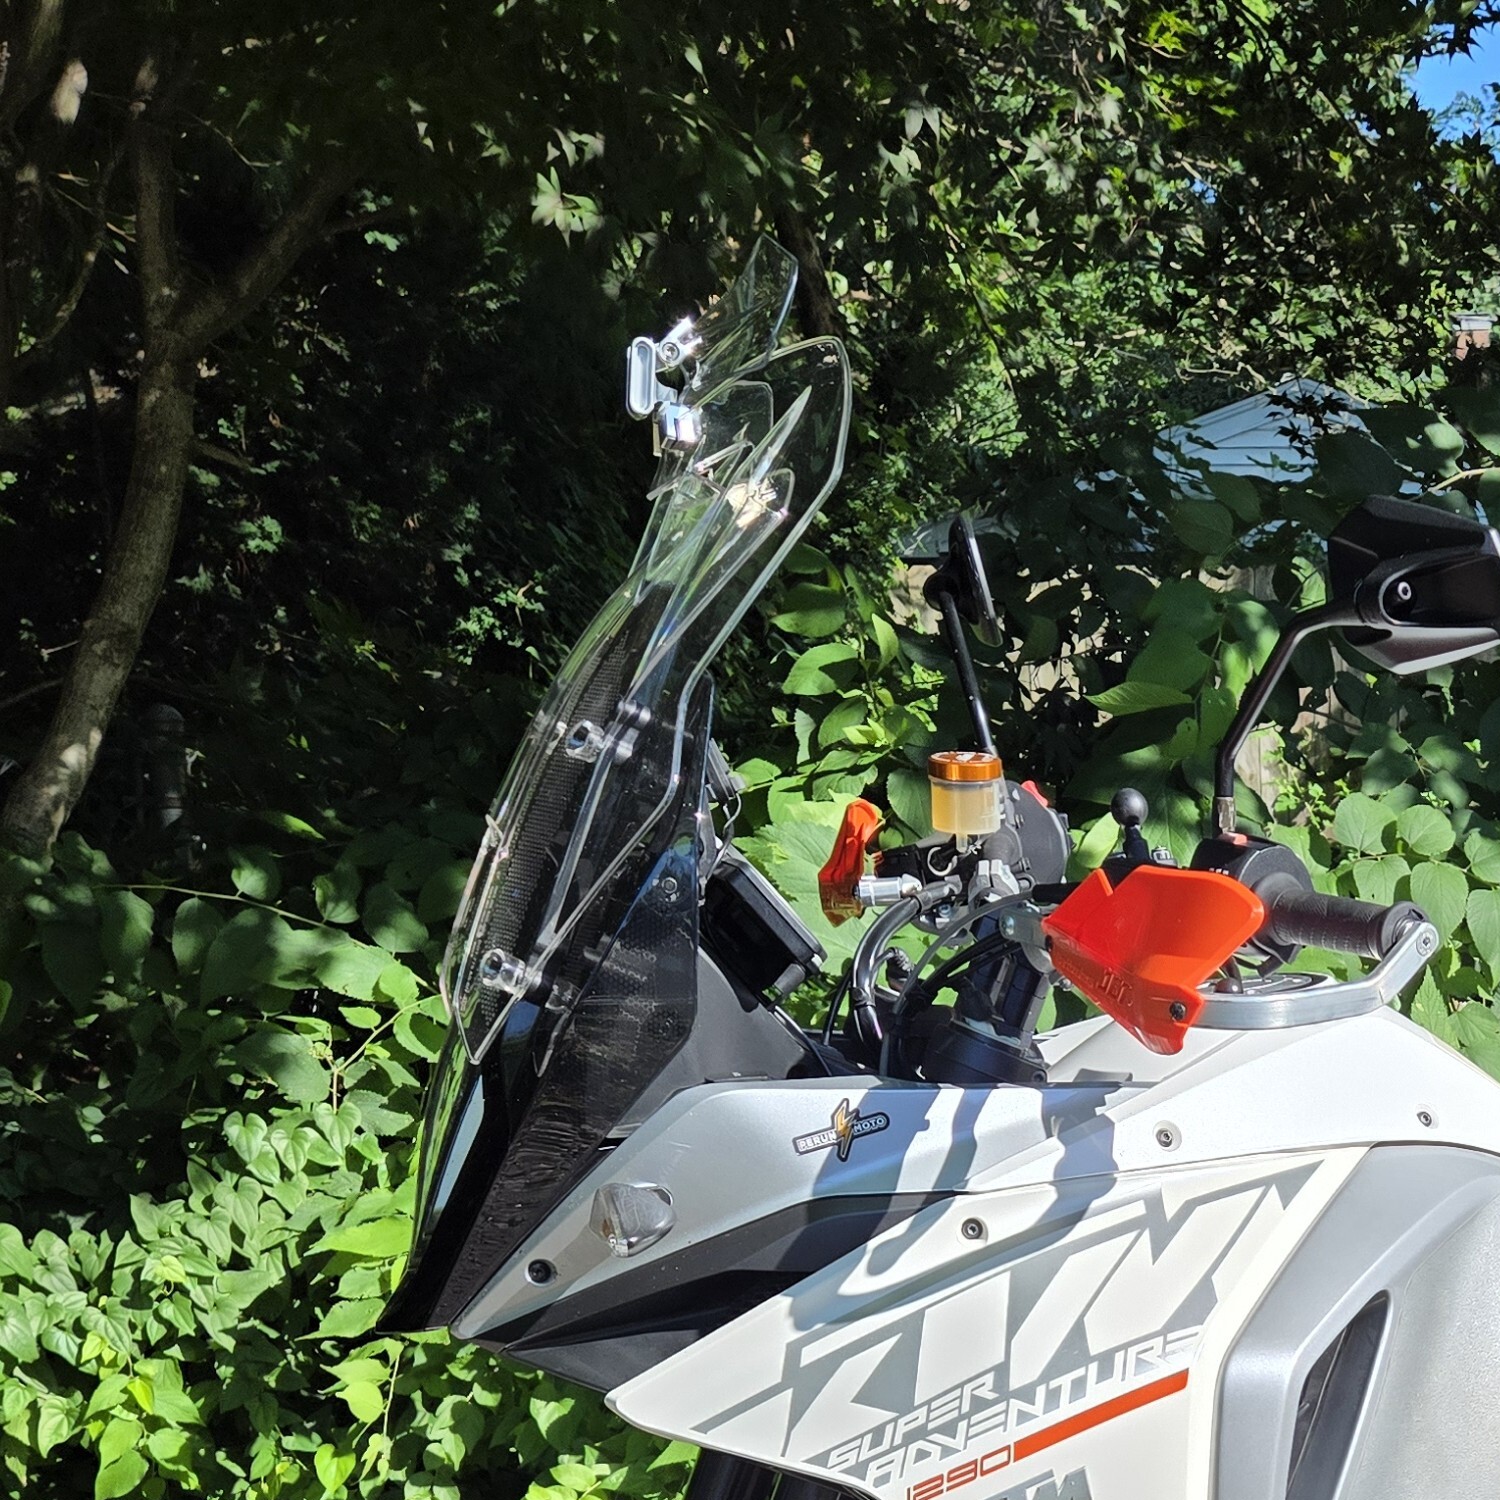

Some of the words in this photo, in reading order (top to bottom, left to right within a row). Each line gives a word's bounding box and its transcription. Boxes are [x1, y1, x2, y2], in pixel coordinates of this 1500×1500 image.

[797, 1130, 838, 1151] PERUN
[853, 1117, 885, 1133] MOTO
[828, 1373, 1001, 1470] SUPER
[866, 1326, 1203, 1488] ADVENTURE
